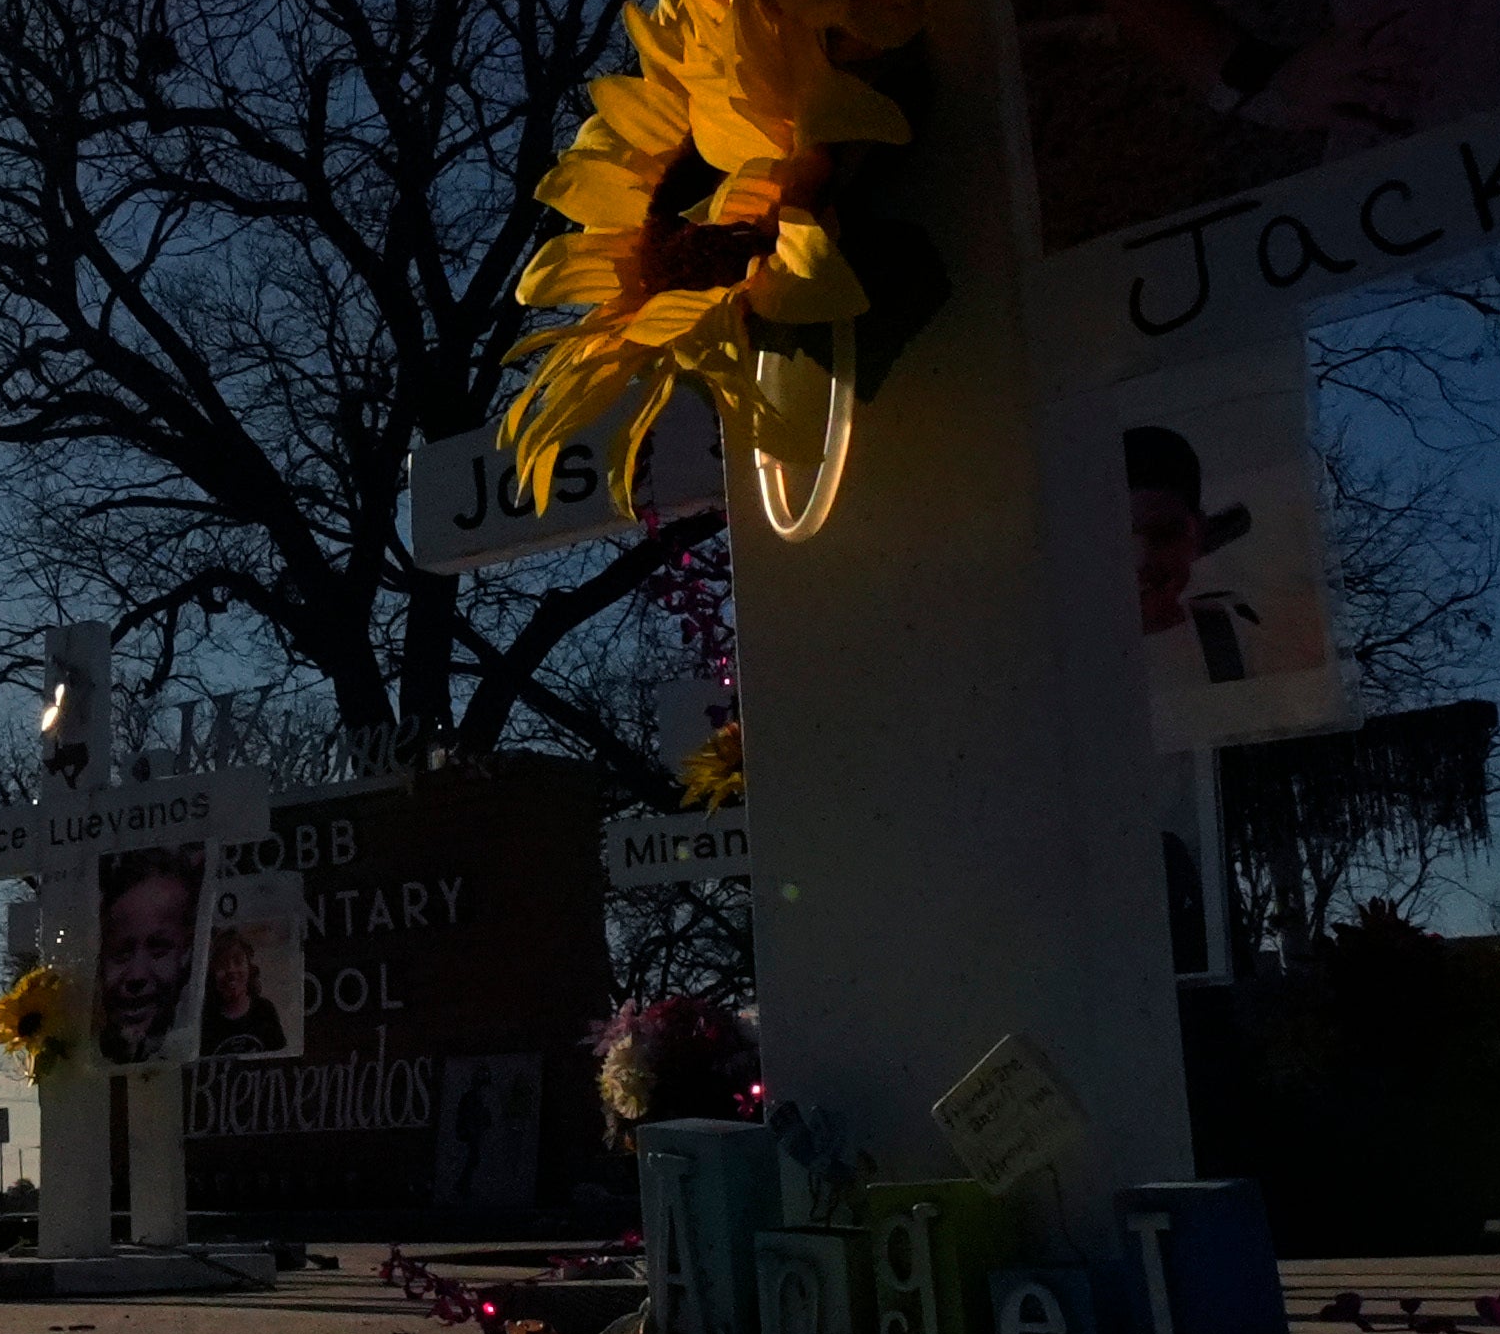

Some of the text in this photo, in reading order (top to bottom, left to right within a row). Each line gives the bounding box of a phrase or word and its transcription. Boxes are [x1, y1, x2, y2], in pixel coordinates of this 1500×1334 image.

[453, 444, 625, 530] Jos
[48, 789, 212, 846] Luevanos
[219, 819, 358, 878] ROBB
[624, 828, 749, 868] Miran
[186, 1023, 433, 1138] Bienvenidos
